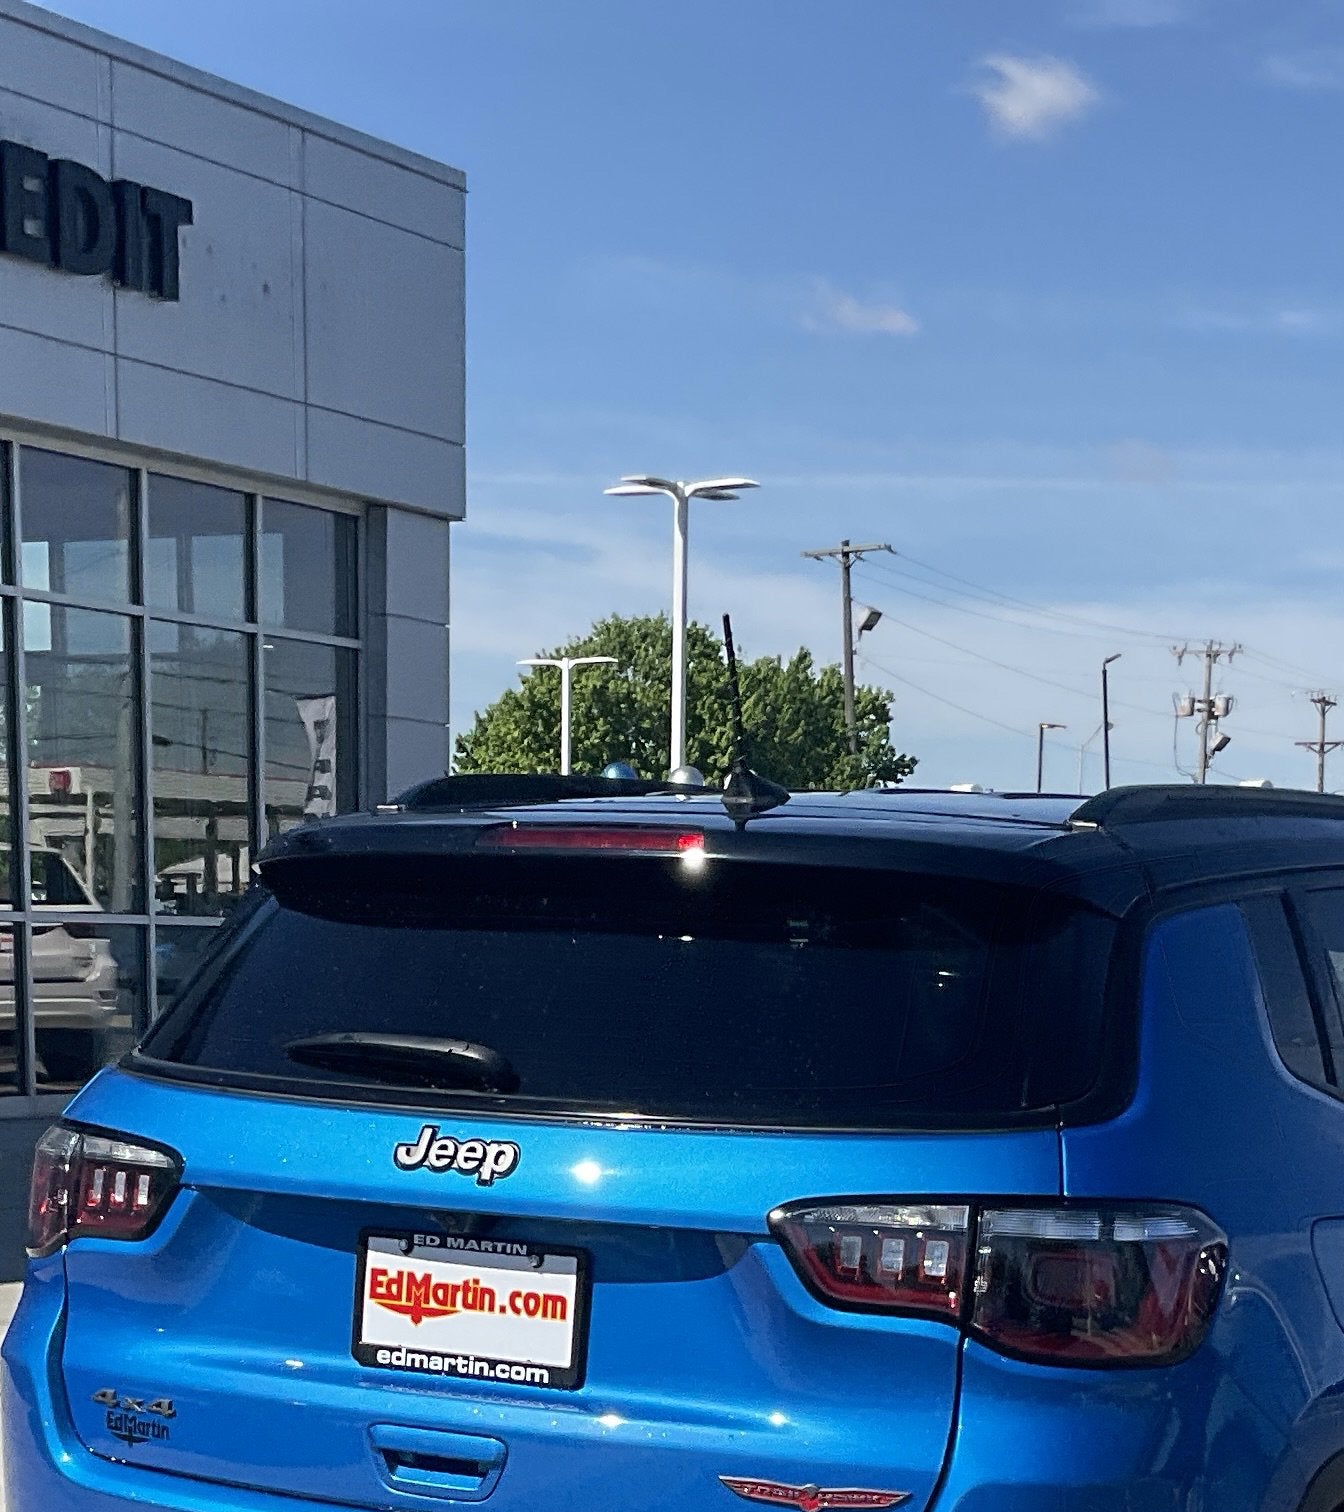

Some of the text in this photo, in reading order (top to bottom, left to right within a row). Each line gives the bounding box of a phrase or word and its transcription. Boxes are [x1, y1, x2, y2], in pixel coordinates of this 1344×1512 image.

[395, 1125, 520, 1185] Jeep
[413, 1234, 527, 1256] ED MARTIN
[376, 1348, 549, 1383] edmartin.com
